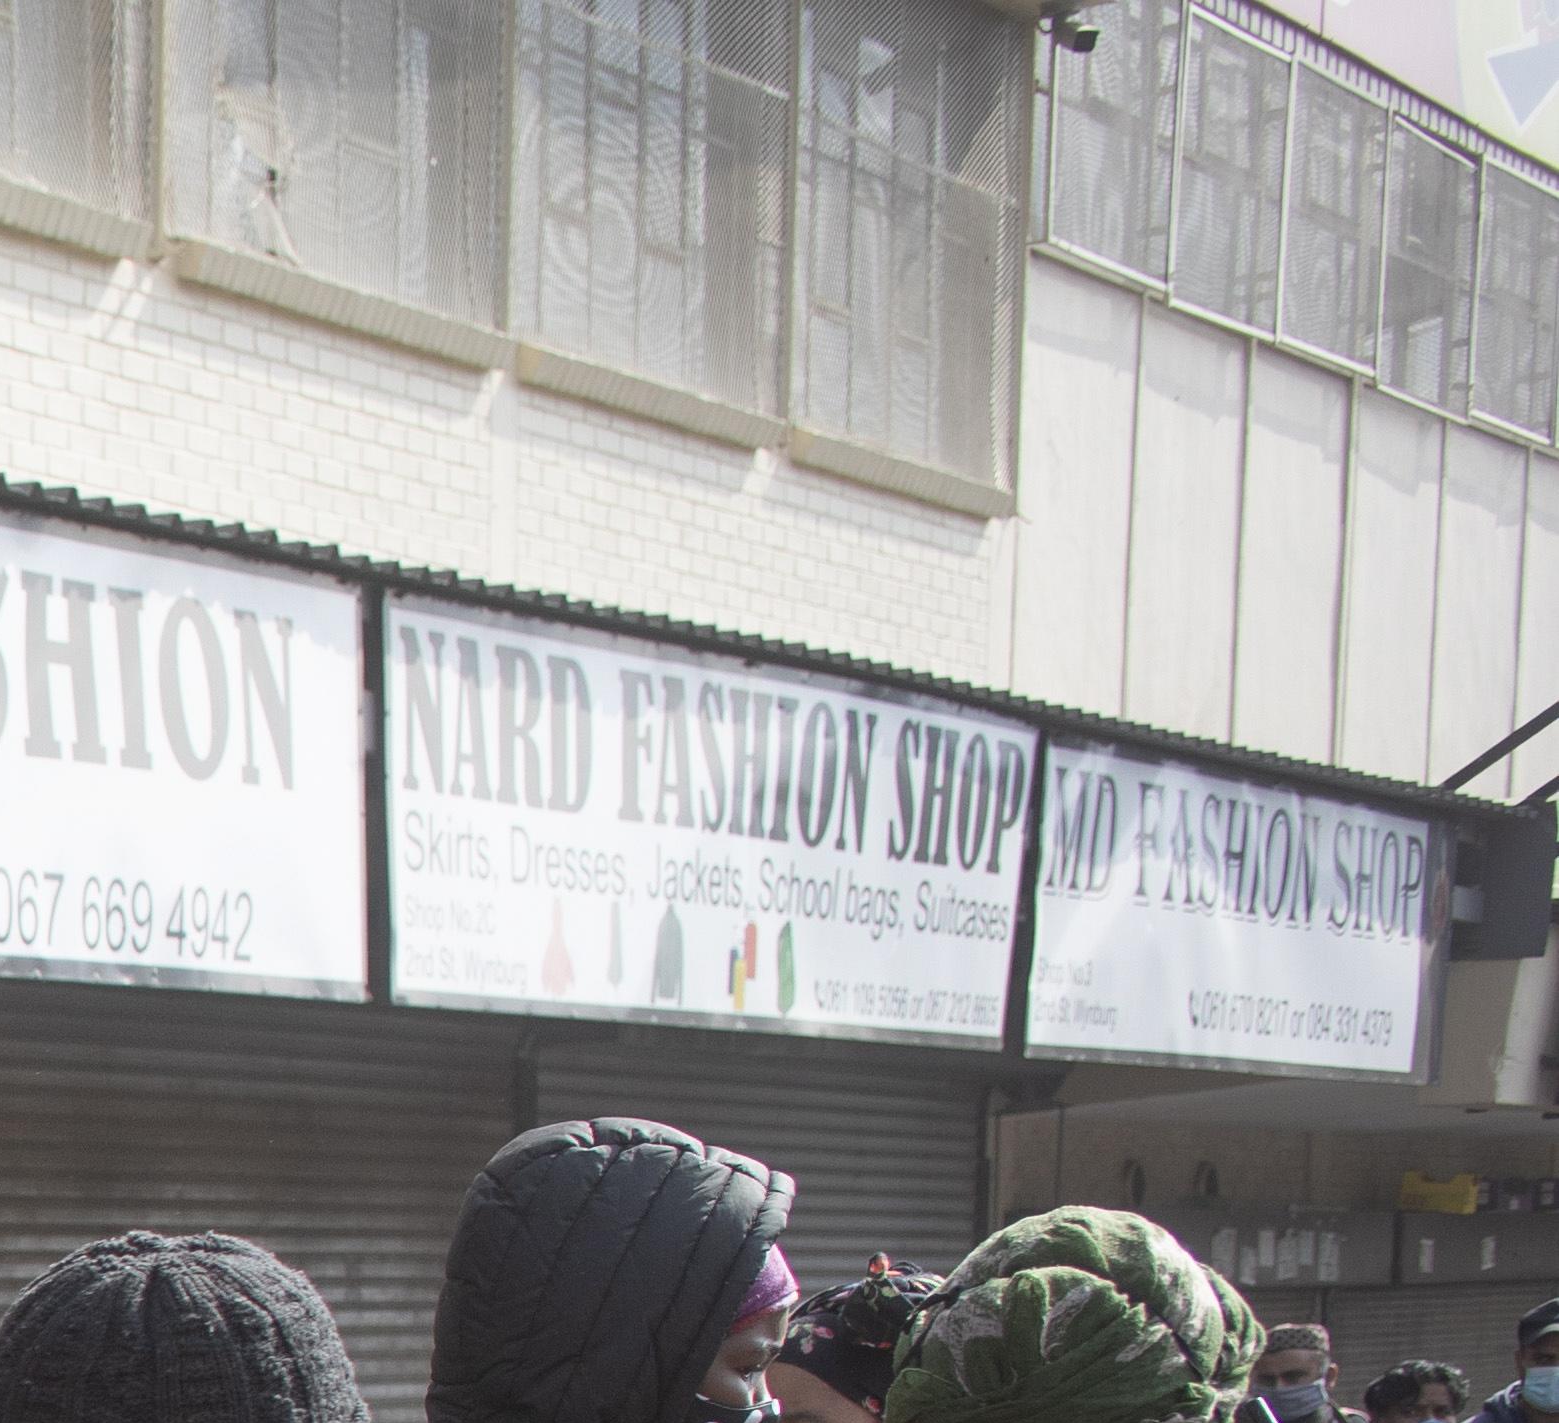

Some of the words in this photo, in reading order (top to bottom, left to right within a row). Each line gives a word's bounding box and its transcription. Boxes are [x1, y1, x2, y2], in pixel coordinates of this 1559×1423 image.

[399, 625, 593, 814] NARD
[618, 669, 879, 854] FASHION
[888, 718, 1027, 875] SHOP
[82, 876, 153, 953] 669
[165, 885, 253, 961] 4942
[404, 810, 499, 890] Skirts,
[511, 825, 635, 904] Dresses,
[647, 841, 748, 912] Jackets,
[759, 858, 840, 921] School
[846, 870, 904, 937] bags,
[914, 880, 1009, 942] Suitcases
[405, 894, 443, 937] Shop
[1044, 767, 1118, 900] MD
[1134, 781, 1321, 930] FASHION
[1326, 819, 1423, 944] SHOP
